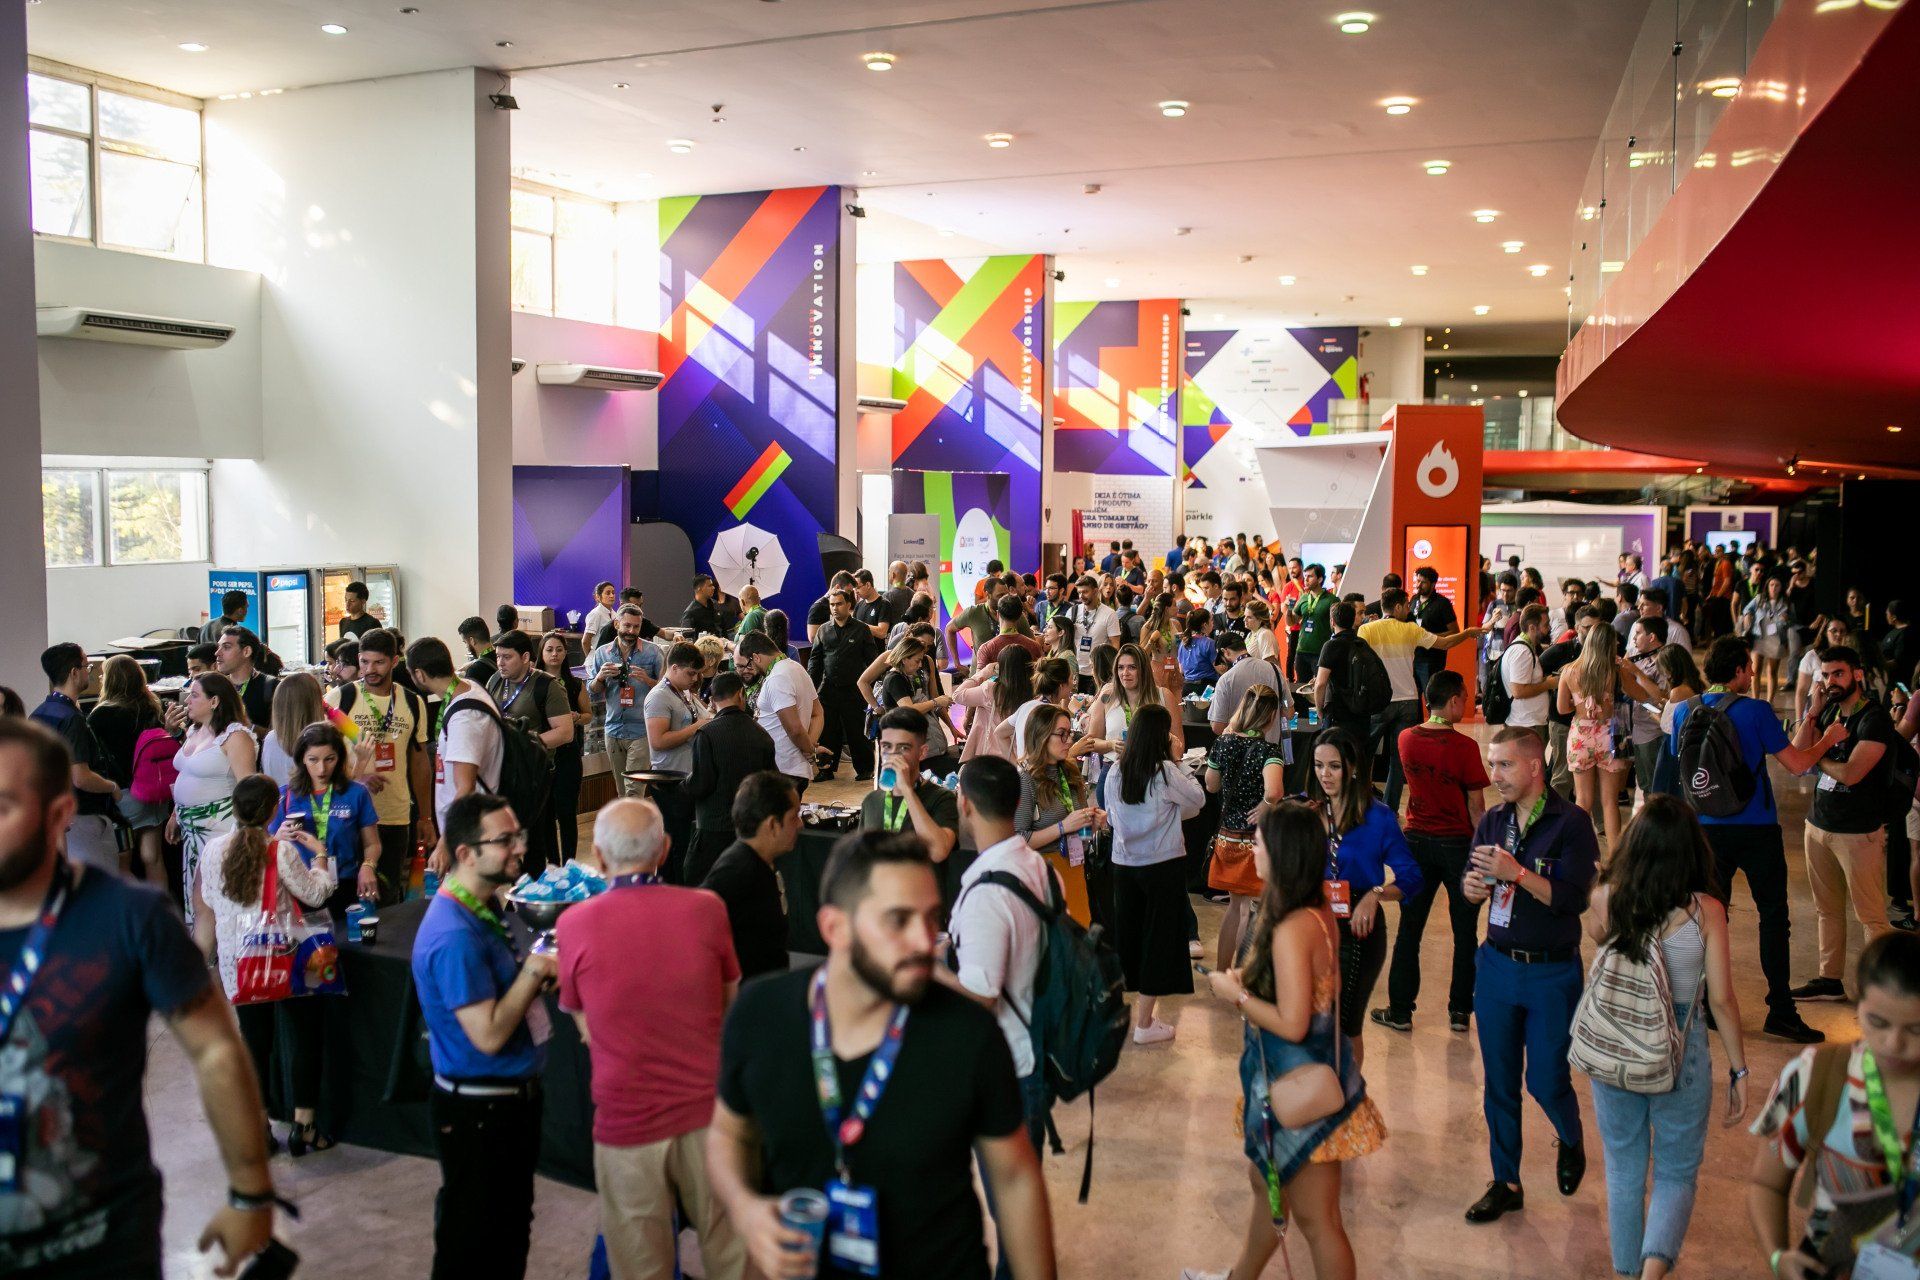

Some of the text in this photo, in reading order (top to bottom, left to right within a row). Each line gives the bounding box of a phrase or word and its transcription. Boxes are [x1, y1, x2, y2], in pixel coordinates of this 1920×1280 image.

[813, 244, 823, 374] INNOVATION
[1022, 287, 1032, 406] RELATIONSHIP
[1115, 521, 1148, 529] GESTÃO?
[279, 578, 298, 587] pepsi
